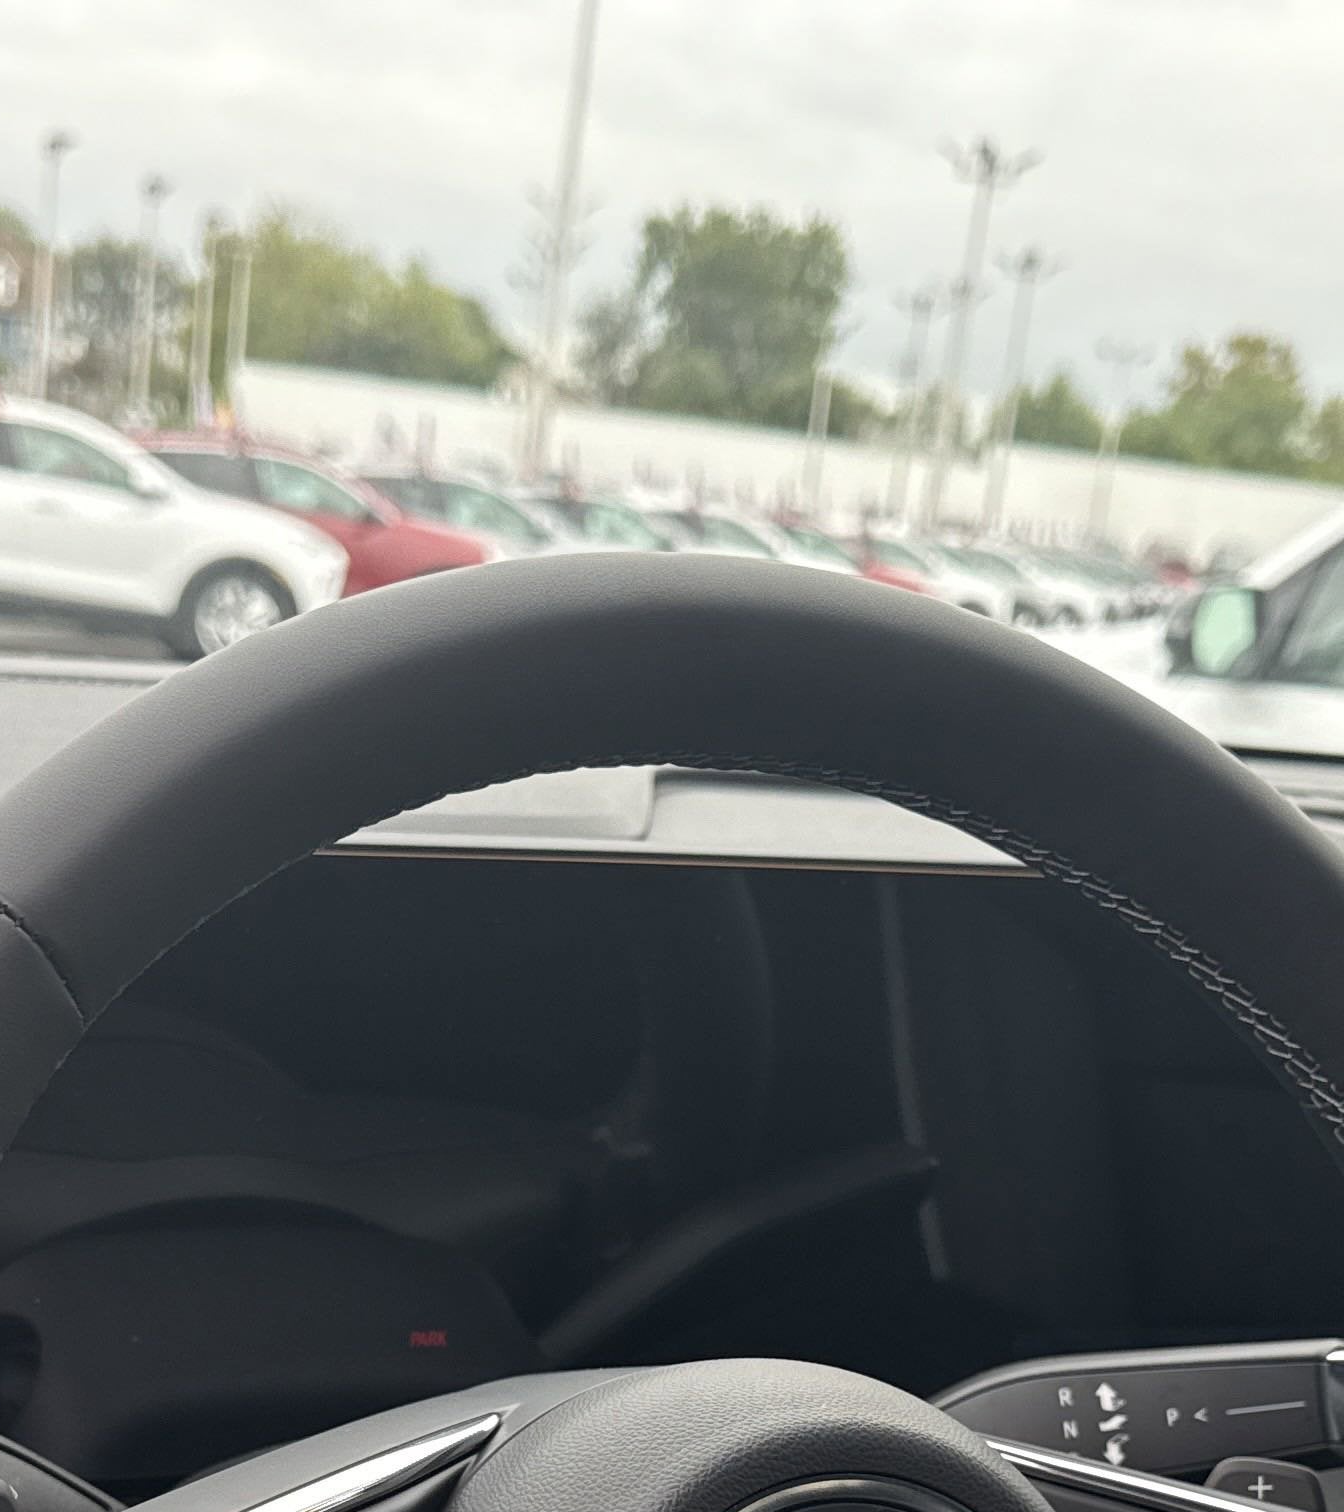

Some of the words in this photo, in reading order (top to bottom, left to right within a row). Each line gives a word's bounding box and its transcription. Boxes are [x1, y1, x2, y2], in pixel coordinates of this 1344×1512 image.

[409, 1331, 448, 1346] PARK
[1058, 1387, 1073, 1407] R
[1166, 1407, 1180, 1427] P
[1063, 1420, 1079, 1439] N
